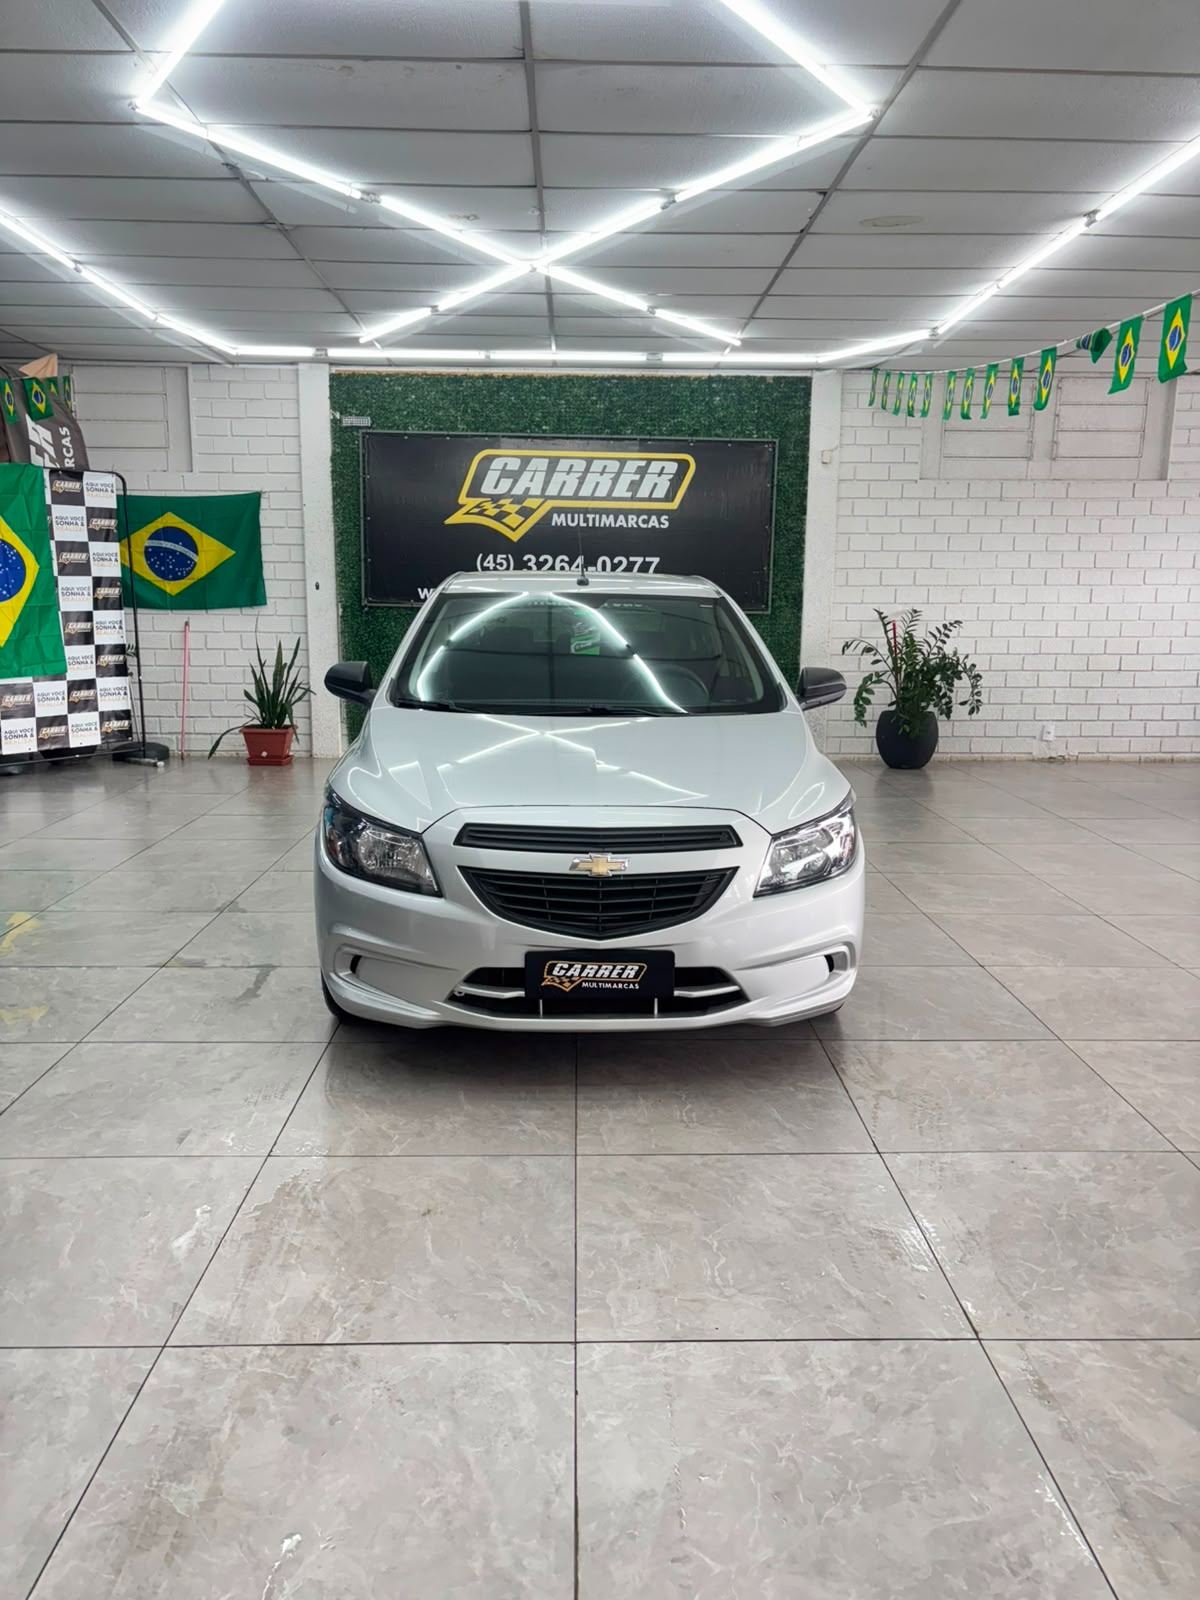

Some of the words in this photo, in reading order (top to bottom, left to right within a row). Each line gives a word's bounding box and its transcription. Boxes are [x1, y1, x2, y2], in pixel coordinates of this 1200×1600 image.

[480, 457, 679, 498] CARRER
[551, 513, 670, 528] MULTIMARCAS
[476, 554, 514, 572] (45)
[522, 555, 661, 573] 3264-0277
[552, 963, 640, 979] CARRER
